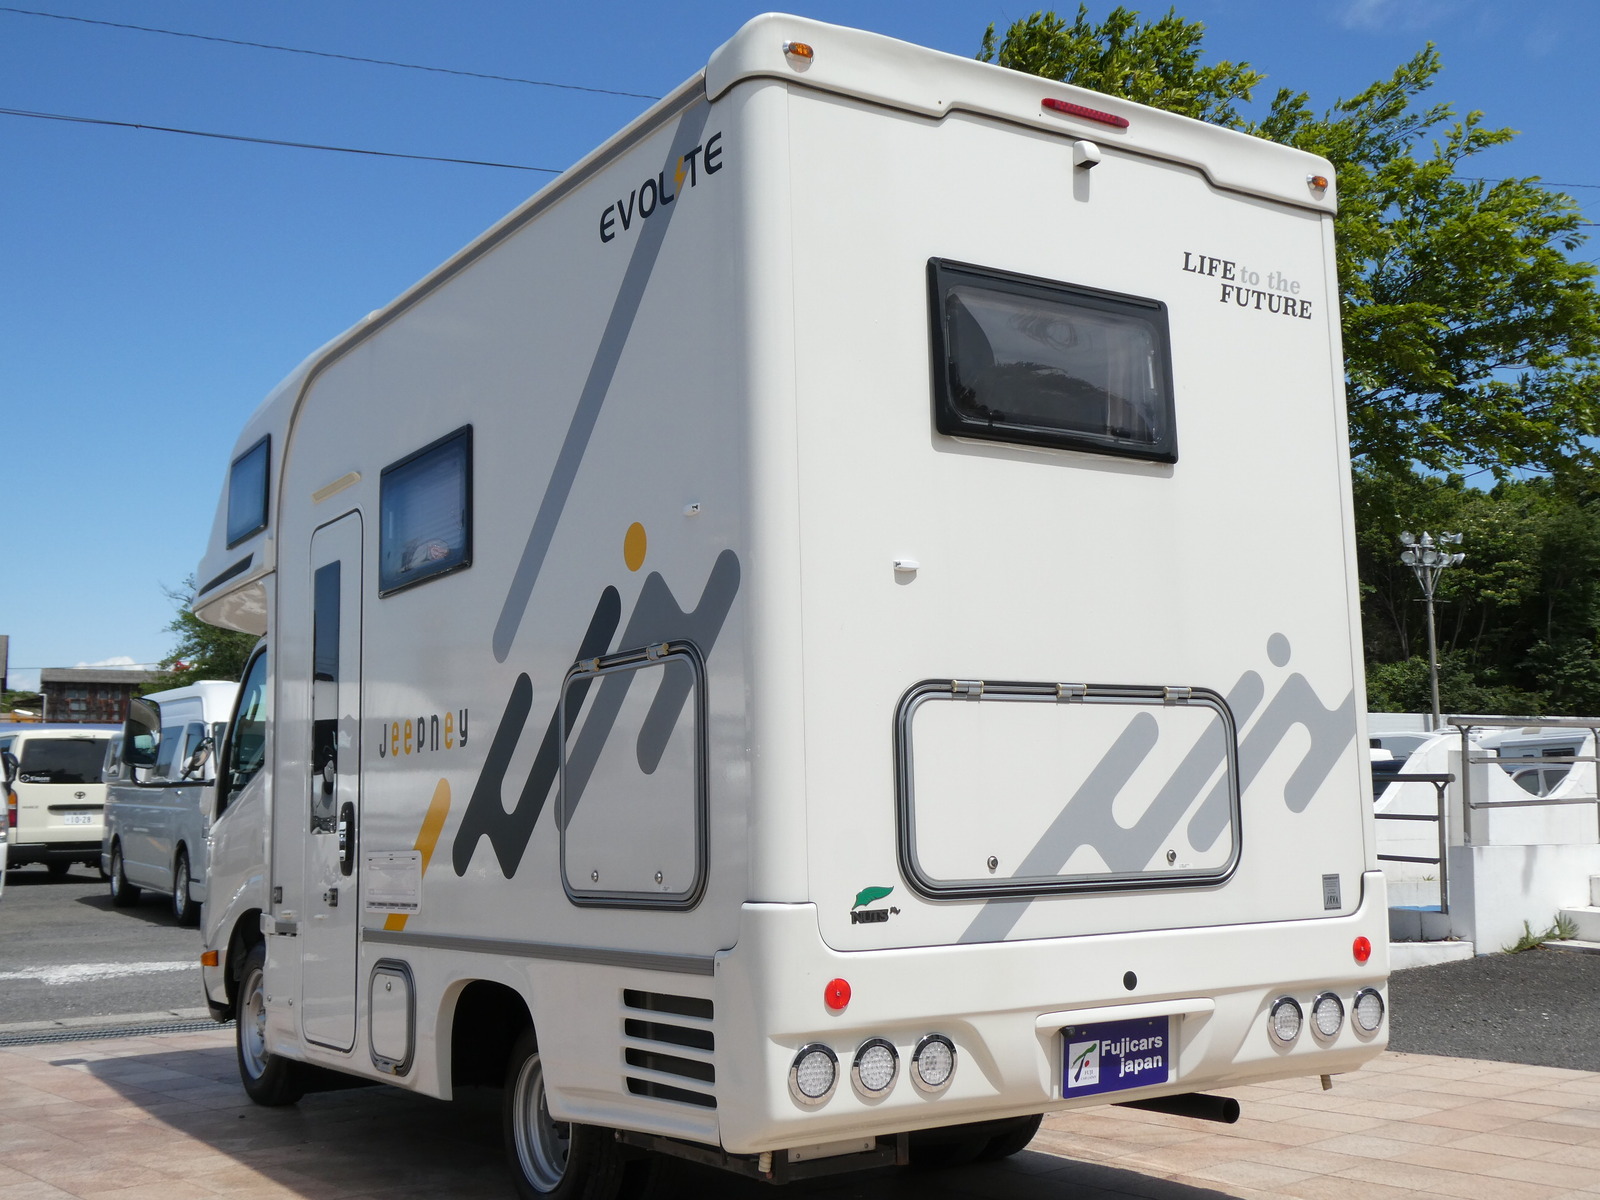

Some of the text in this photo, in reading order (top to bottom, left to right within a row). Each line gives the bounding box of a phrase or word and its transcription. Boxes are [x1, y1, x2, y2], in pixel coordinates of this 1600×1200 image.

[1183, 251, 1301, 295] LIFE to the
[1220, 283, 1312, 320] FUTURE
[1101, 1036, 1163, 1058] Fujicars
[1119, 1055, 1163, 1078] japan
